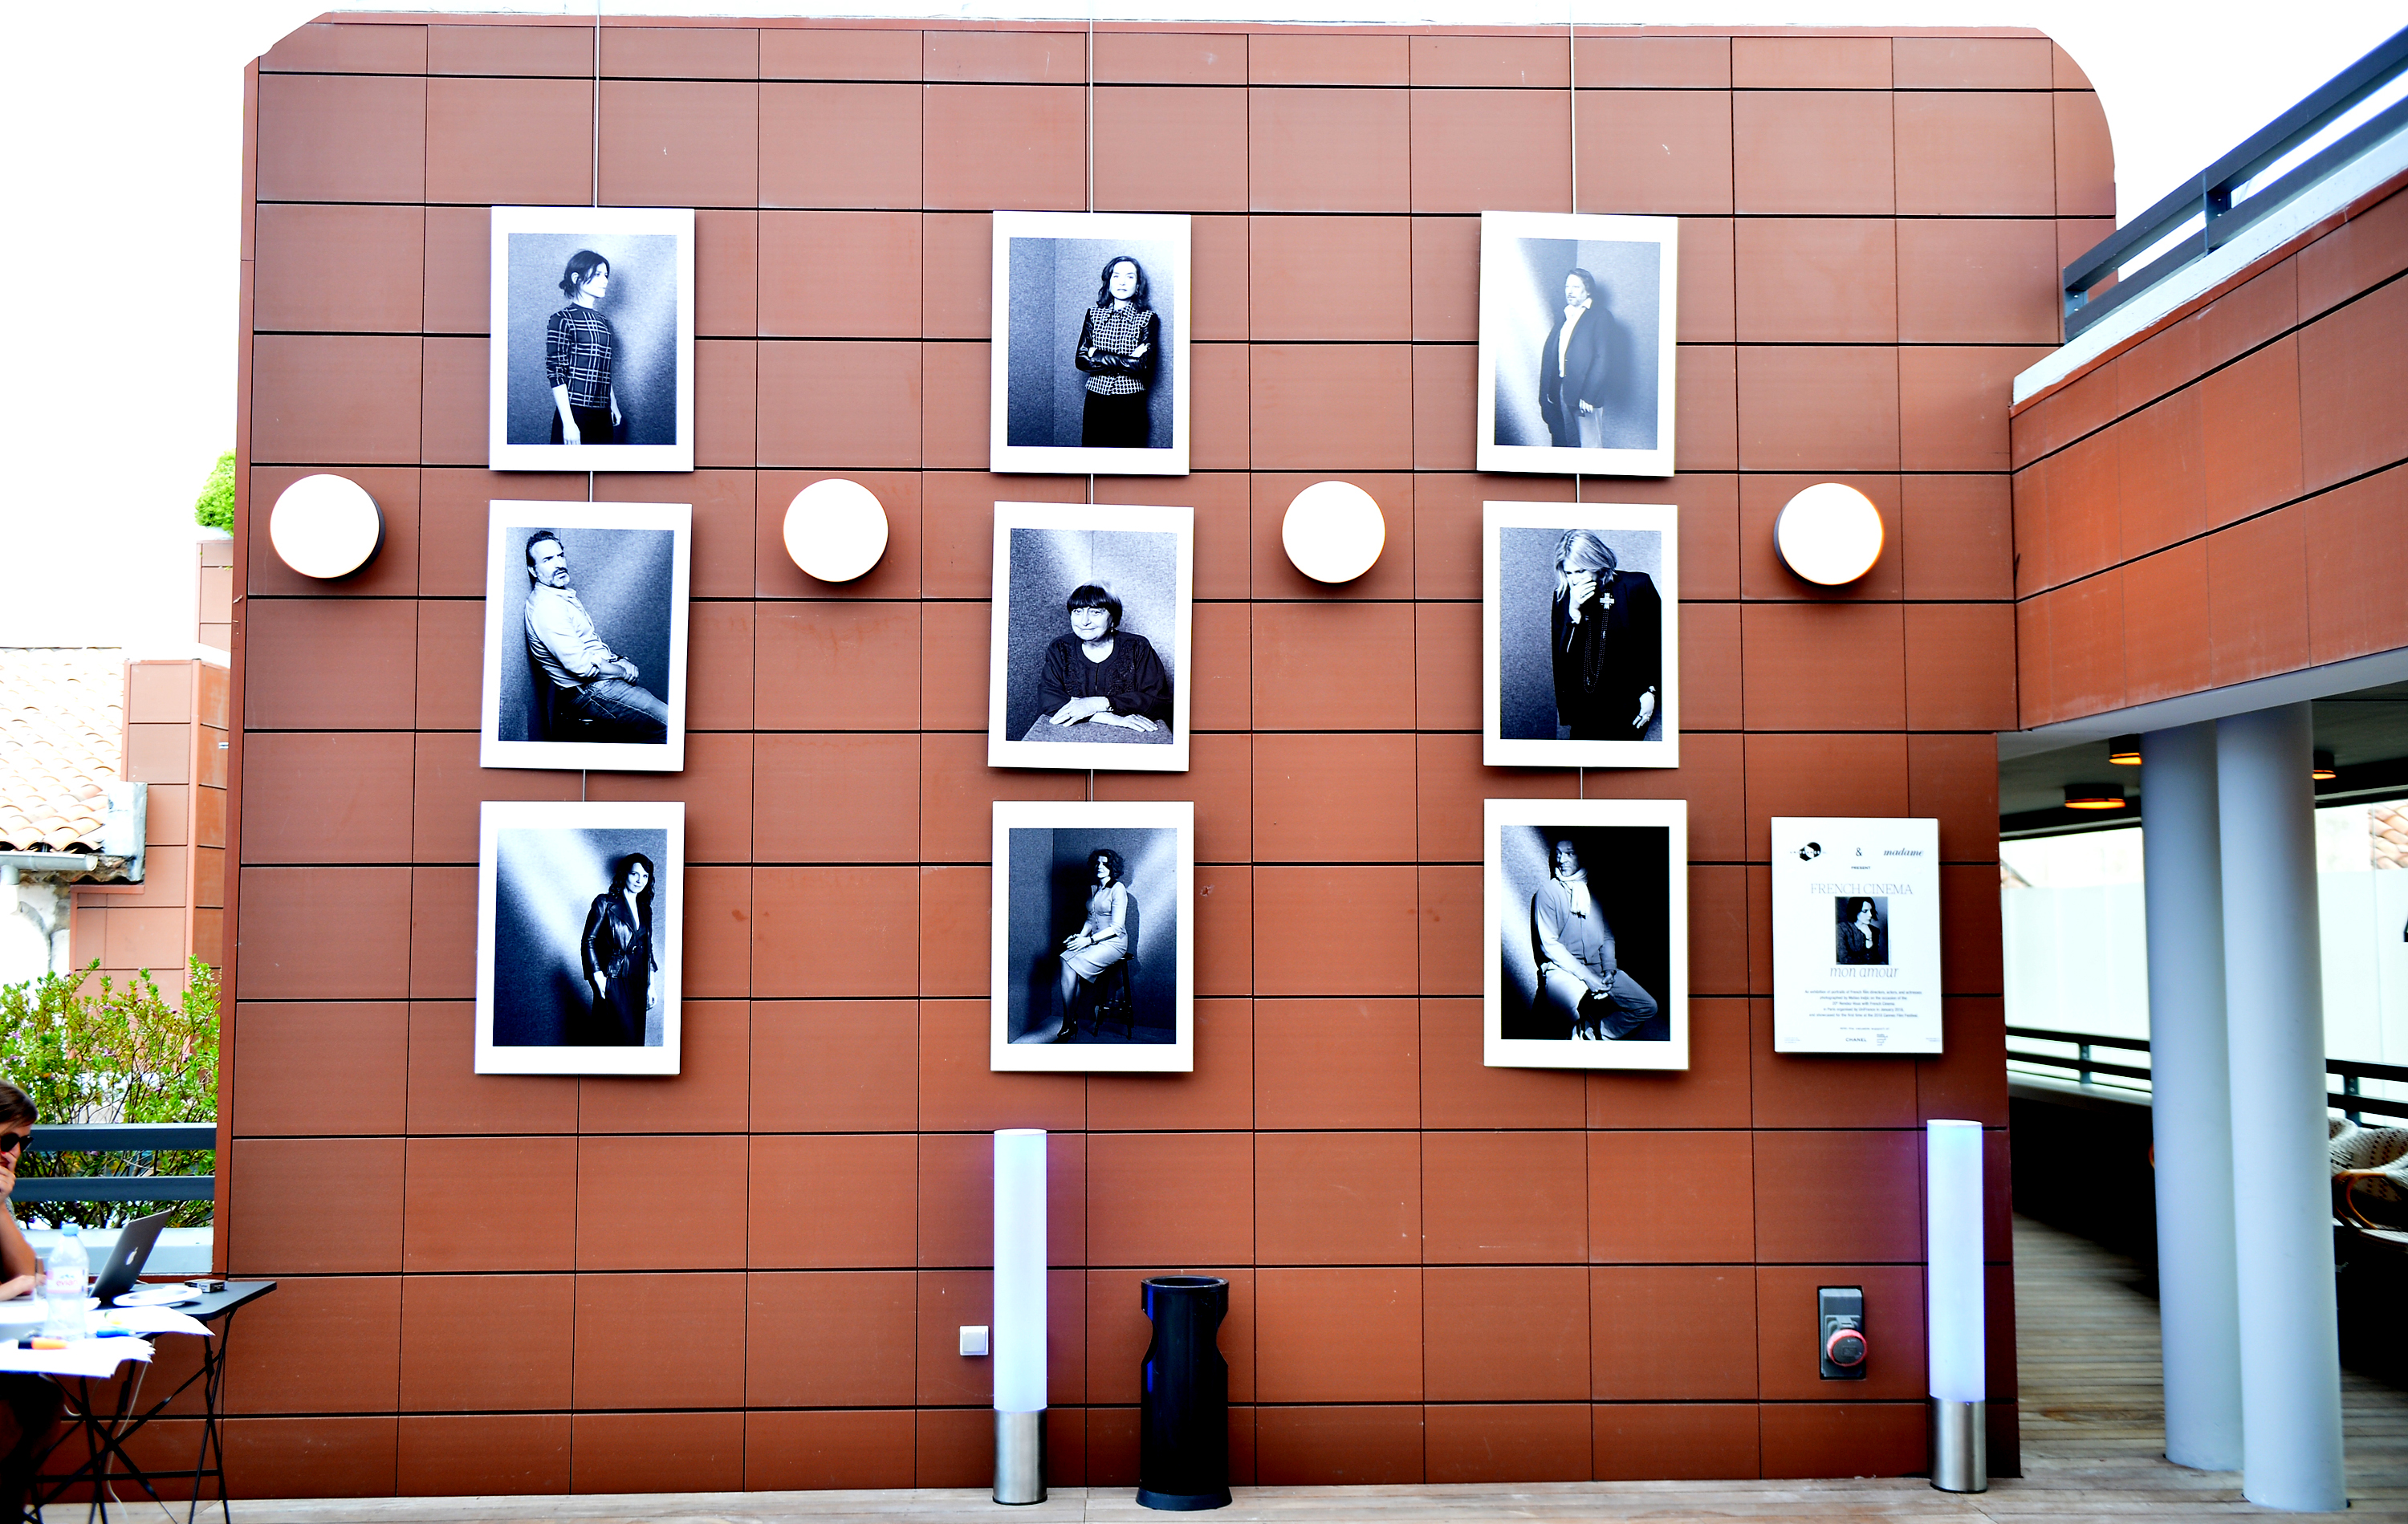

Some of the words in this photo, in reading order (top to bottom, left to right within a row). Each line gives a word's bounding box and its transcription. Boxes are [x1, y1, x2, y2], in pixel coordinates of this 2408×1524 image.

[1855, 847, 1863, 856] &
[1883, 847, 1924, 856] madame
[1811, 884, 1861, 894] FRENCH
[1863, 884, 1914, 895] CINEMA
[1830, 967, 1856, 977] mon
[1859, 967, 1899, 977] amour
